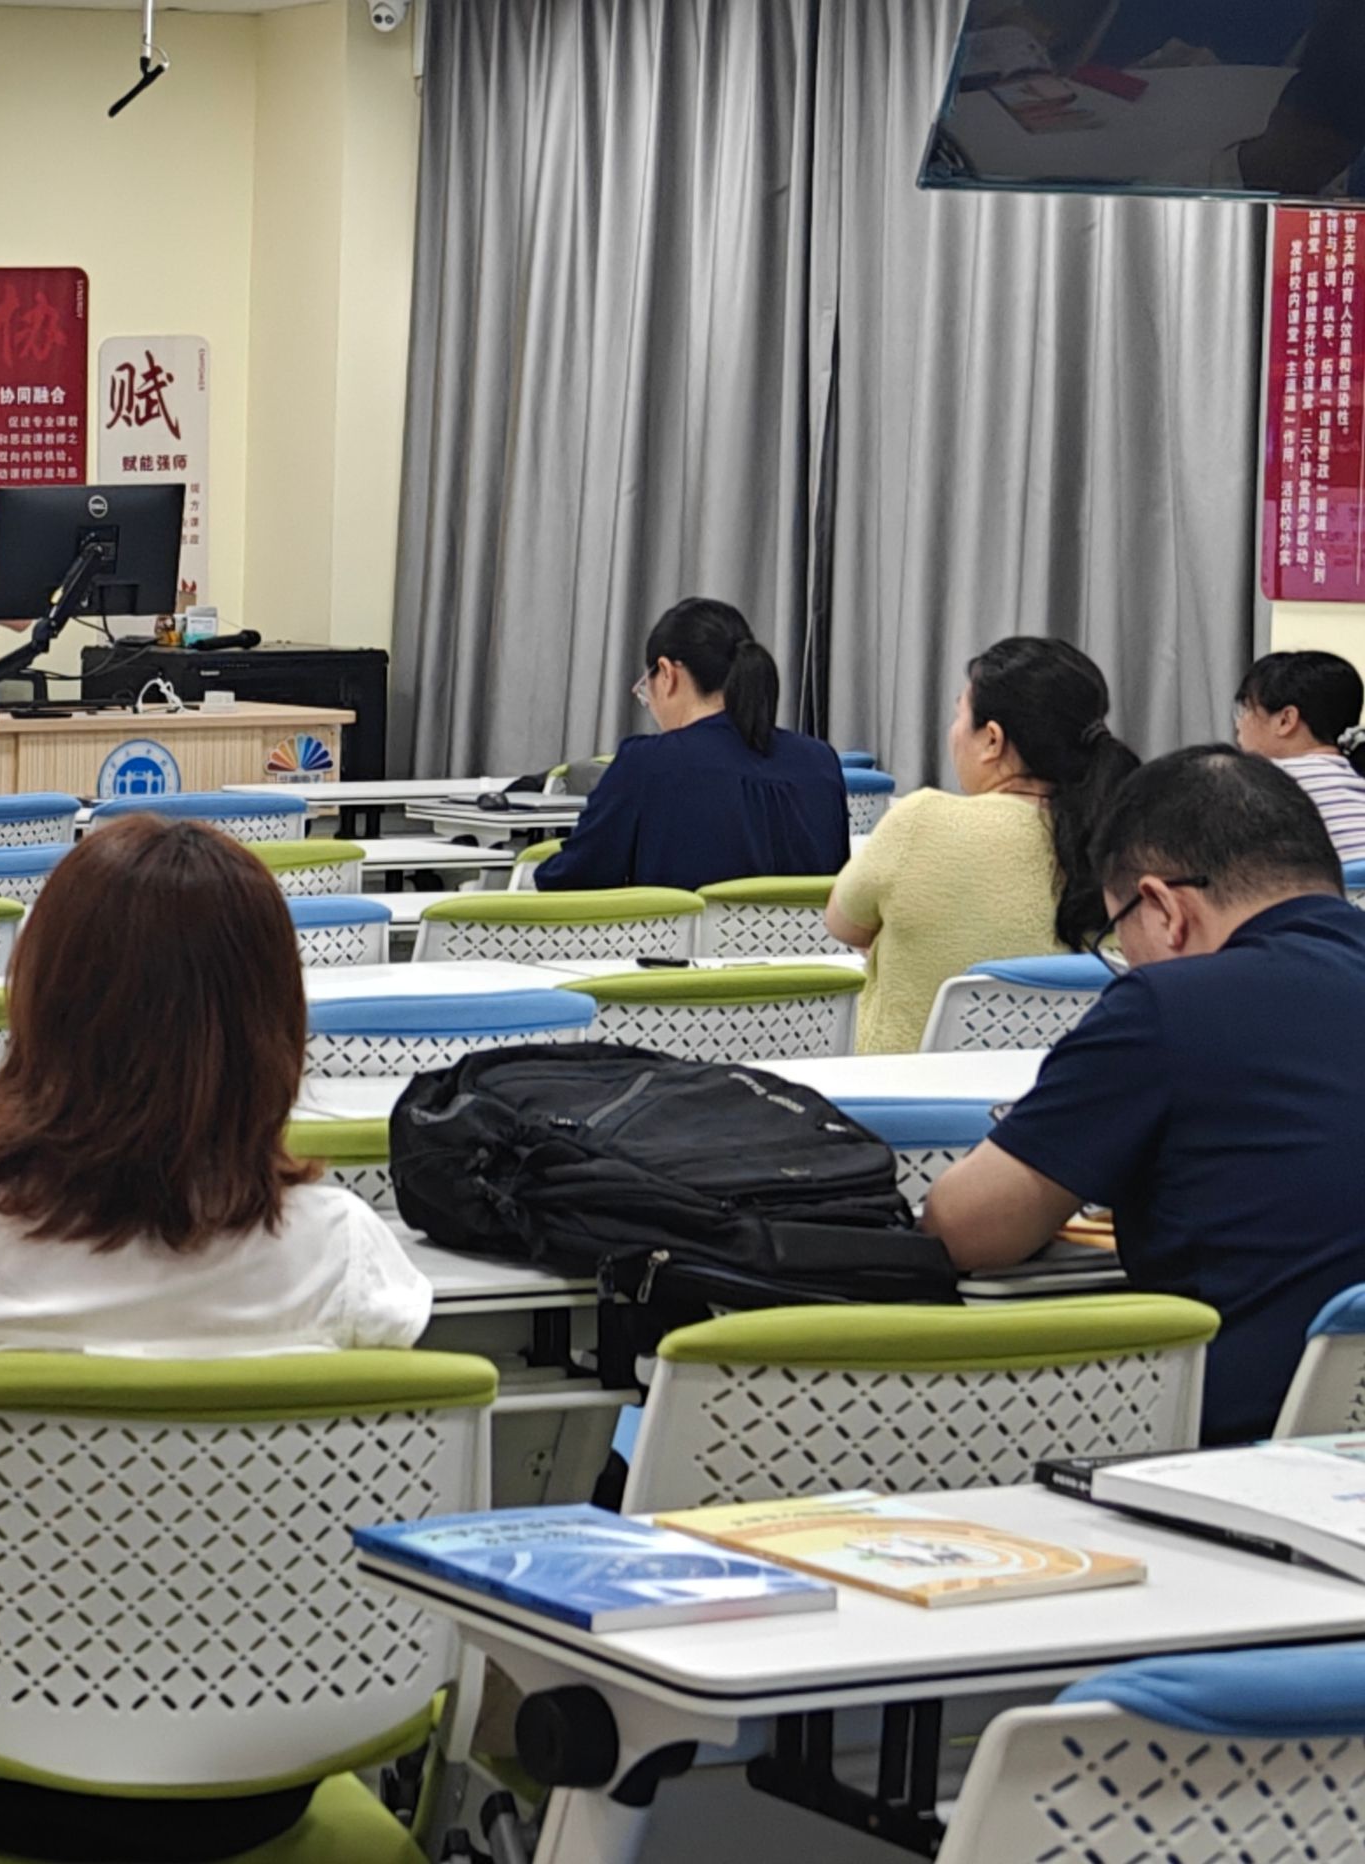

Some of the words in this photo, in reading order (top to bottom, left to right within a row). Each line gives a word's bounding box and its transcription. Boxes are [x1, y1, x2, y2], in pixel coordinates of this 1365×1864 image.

[105, 350, 182, 440] 赋
[122, 455, 188, 472] 赋能强师
